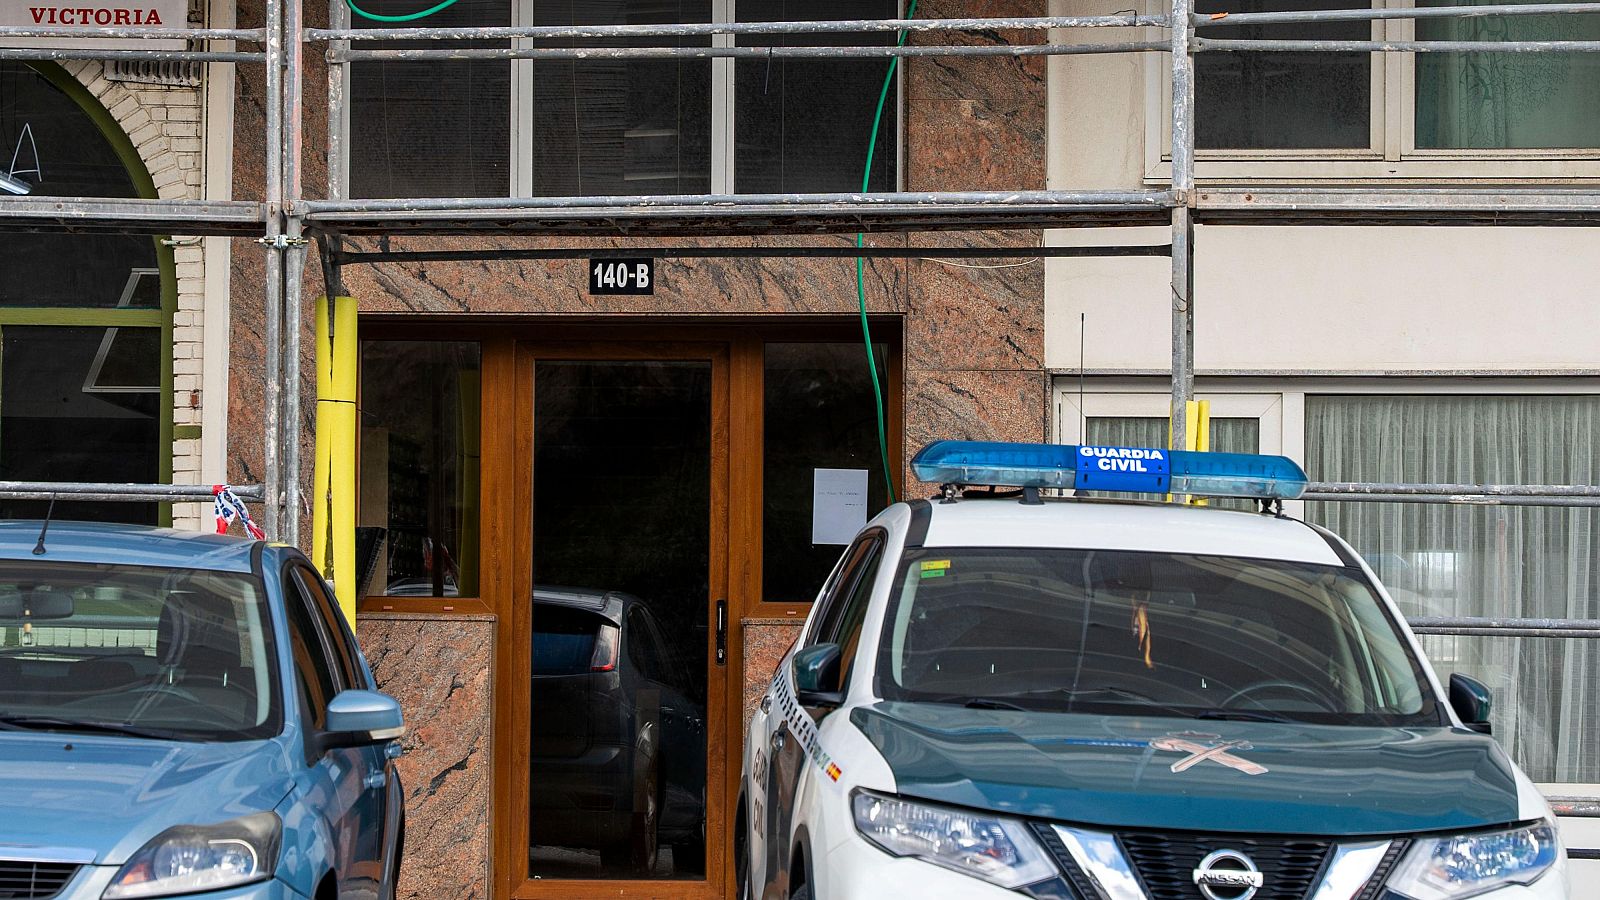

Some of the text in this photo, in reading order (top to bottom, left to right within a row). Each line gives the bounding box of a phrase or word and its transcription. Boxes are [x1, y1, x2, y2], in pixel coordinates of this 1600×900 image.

[29, 7, 163, 25] VICTORIA
[593, 262, 649, 288] 140-B
[1080, 447, 1163, 460] GUARDIA
[1098, 458, 1147, 472] CIVIL
[1200, 873, 1256, 886] NISSAN
